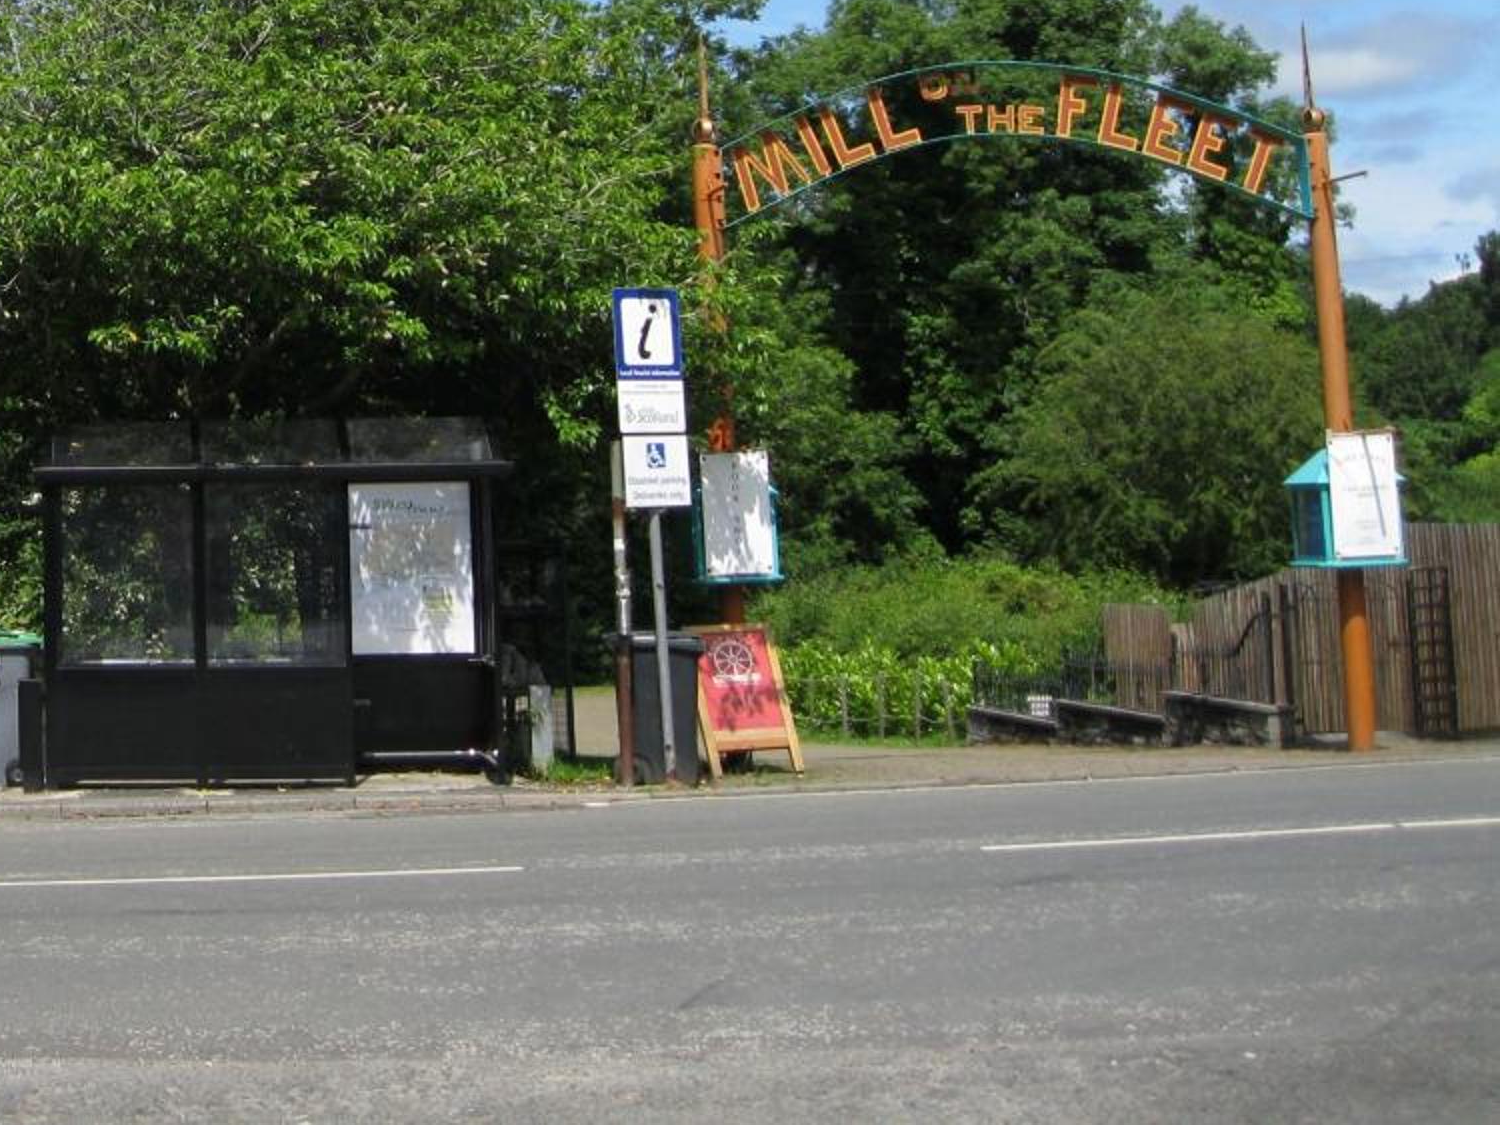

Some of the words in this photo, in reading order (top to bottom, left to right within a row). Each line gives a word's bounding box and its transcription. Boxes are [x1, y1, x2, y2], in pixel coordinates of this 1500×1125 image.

[734, 87, 922, 212] MILL
[955, 105, 1046, 136] THE
[1055, 75, 1284, 196] FLEET
